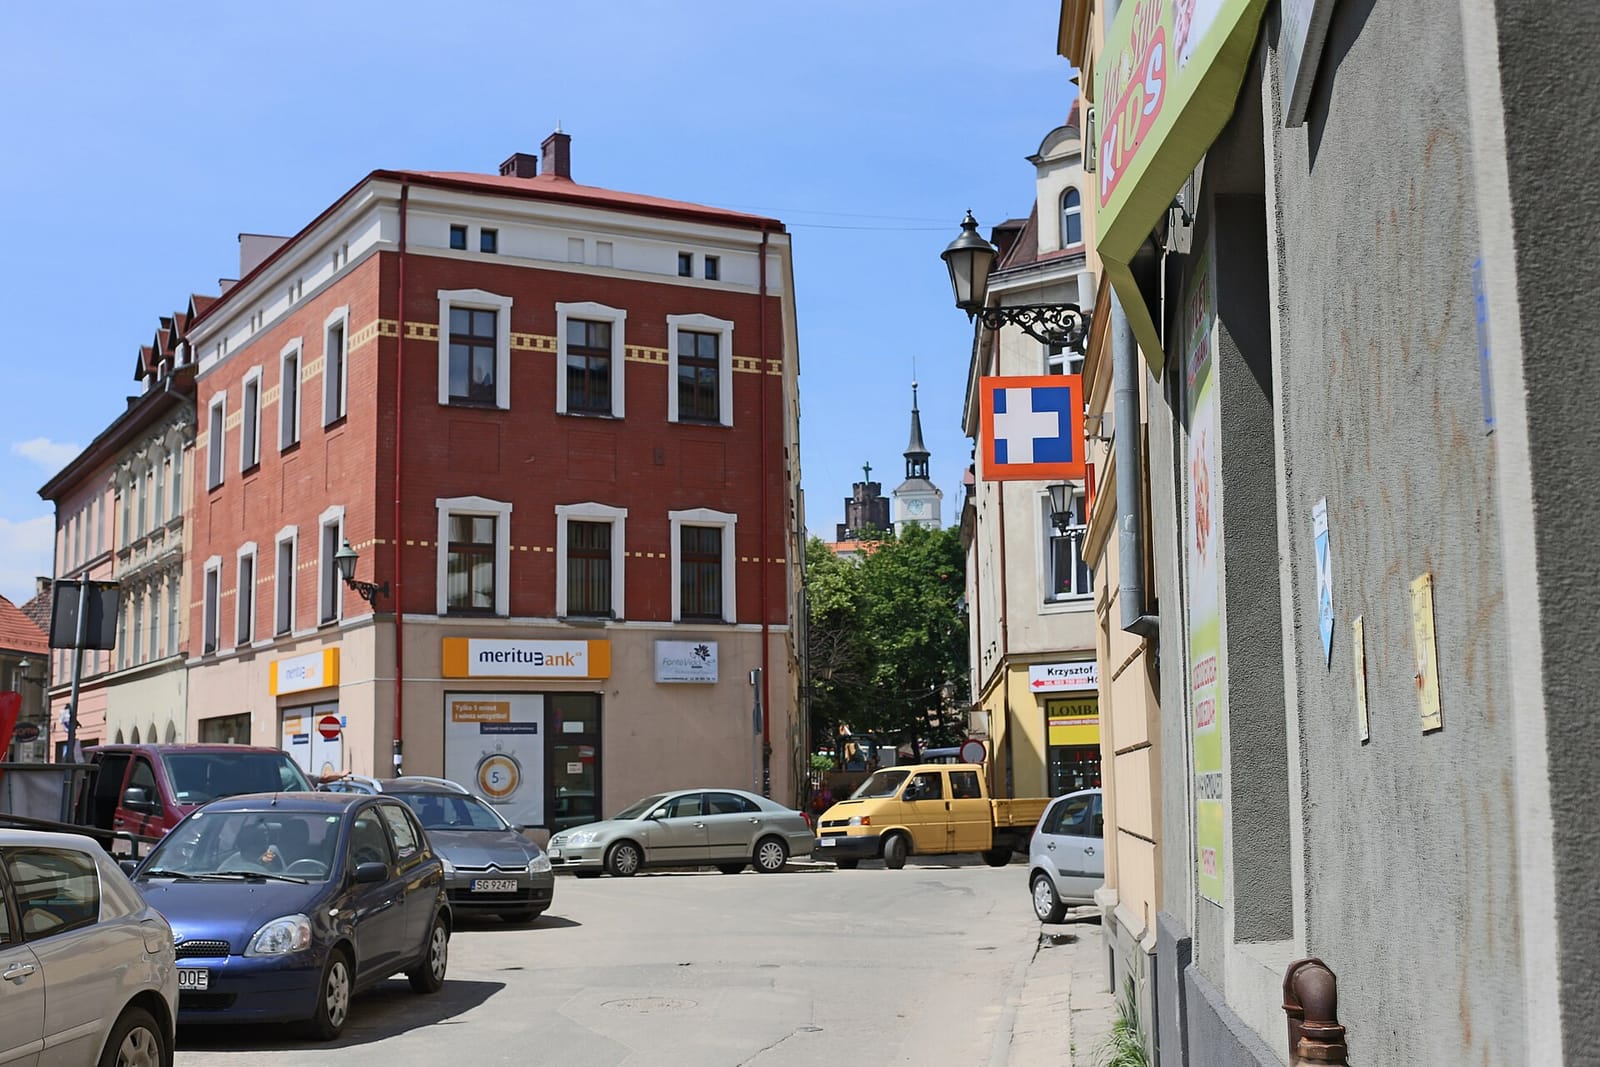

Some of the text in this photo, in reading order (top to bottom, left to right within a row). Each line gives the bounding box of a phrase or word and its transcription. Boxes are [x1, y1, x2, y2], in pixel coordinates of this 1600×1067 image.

[1102, 43, 1163, 196] KIDS
[1047, 666, 1093, 677] Krzysztof
[491, 771, 500, 784] 5
[476, 881, 516, 890] SG 9247F
